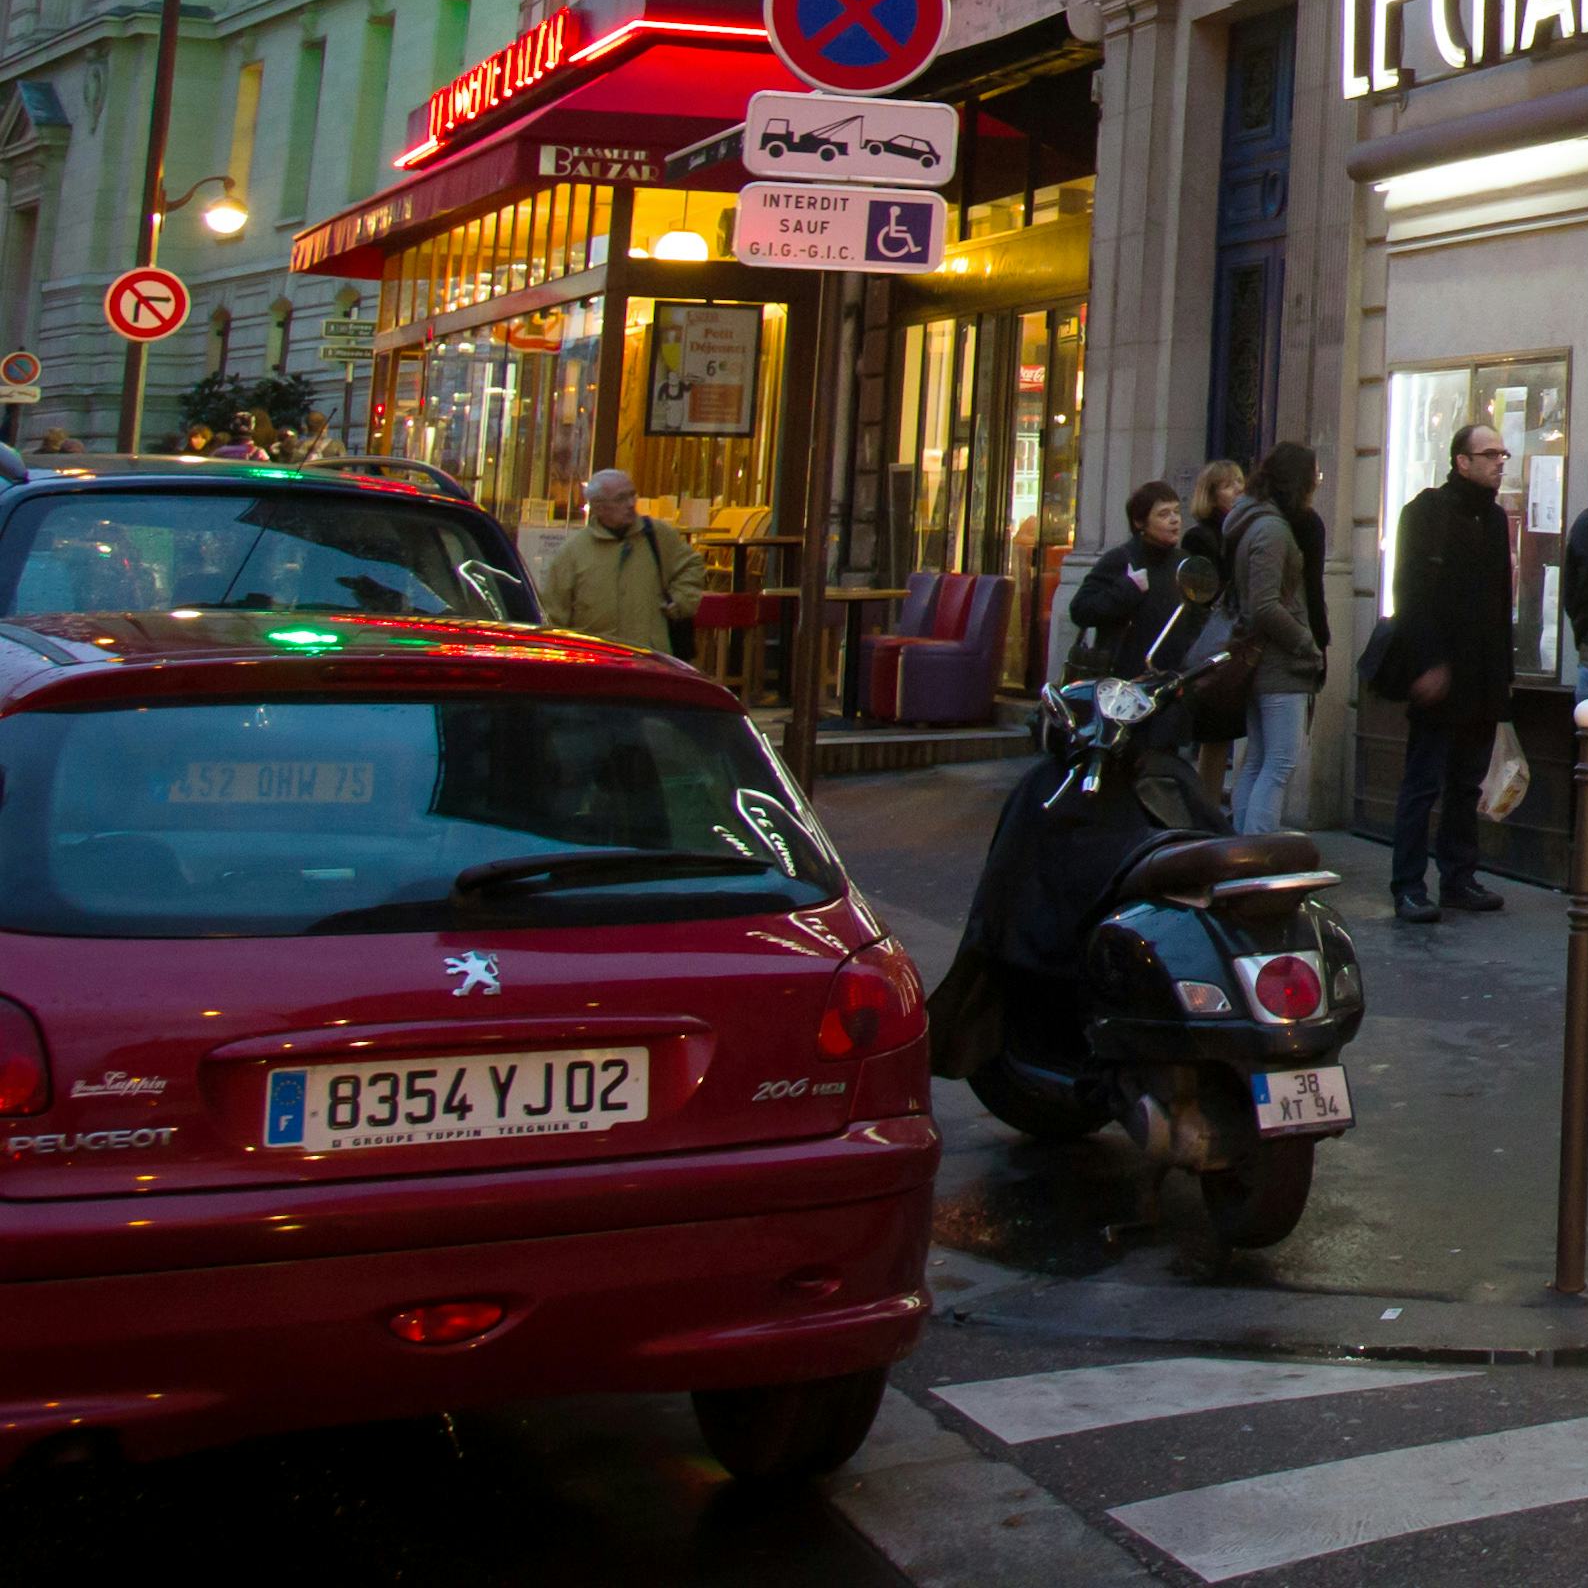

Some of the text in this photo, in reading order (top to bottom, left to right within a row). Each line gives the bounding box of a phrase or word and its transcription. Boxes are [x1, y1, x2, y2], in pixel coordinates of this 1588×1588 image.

[539, 145, 660, 182] BALZAR
[763, 193, 849, 212] INTERDIT
[779, 219, 831, 235] SAUF
[752, 1078, 810, 1102] 206
[1294, 1073, 1320, 1095] 38
[329, 1066, 474, 1131] 8354
[1314, 1095, 1339, 1117] 94
[279, 1115, 293, 1132] F
[352, 1123, 570, 1147] GROUPE TUPPIN TERGNIER
[8, 1127, 179, 1154] PEUGEOT
